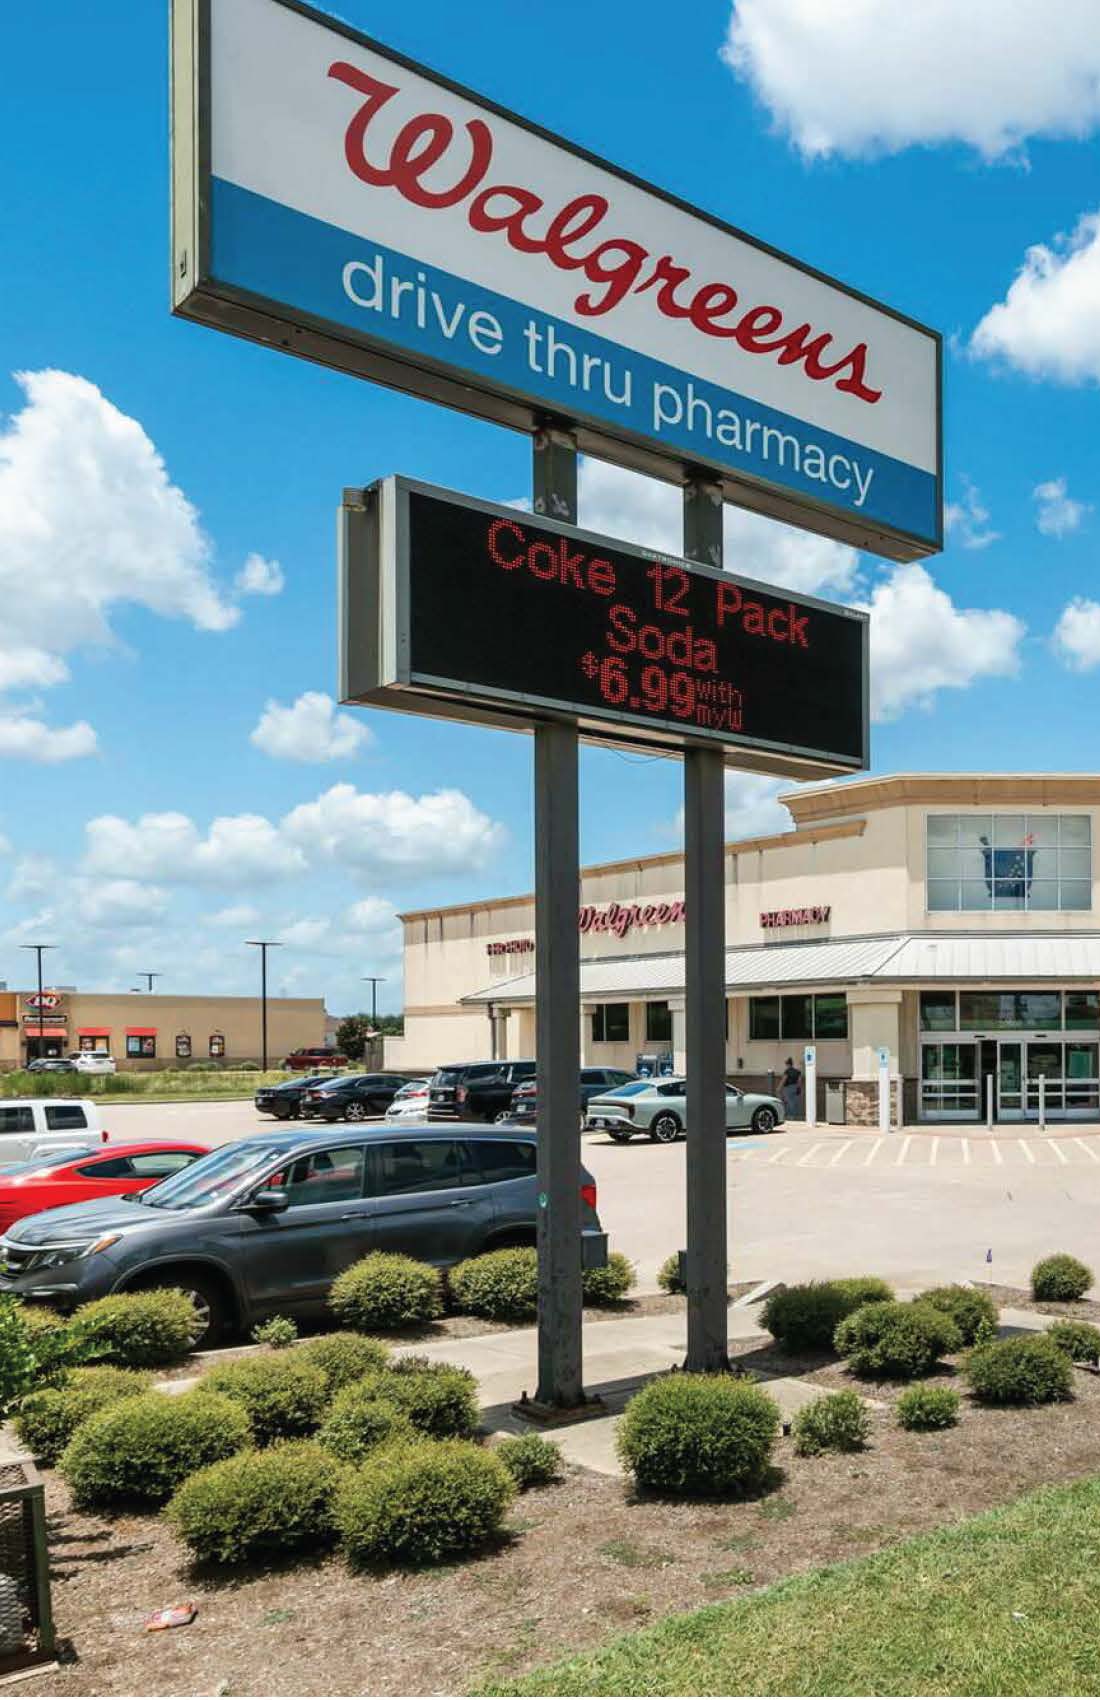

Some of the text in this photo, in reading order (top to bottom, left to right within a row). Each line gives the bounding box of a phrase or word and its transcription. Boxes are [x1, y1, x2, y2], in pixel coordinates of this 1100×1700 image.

[327, 60, 882, 404] Walgreens
[341, 255, 875, 507] drive thru pharmacy
[487, 519, 809, 647] Coke 12 Pack
[581, 651, 695, 718] $6.99
[607, 604, 719, 674] Soda
[760, 905, 832, 928] PHARMACY
